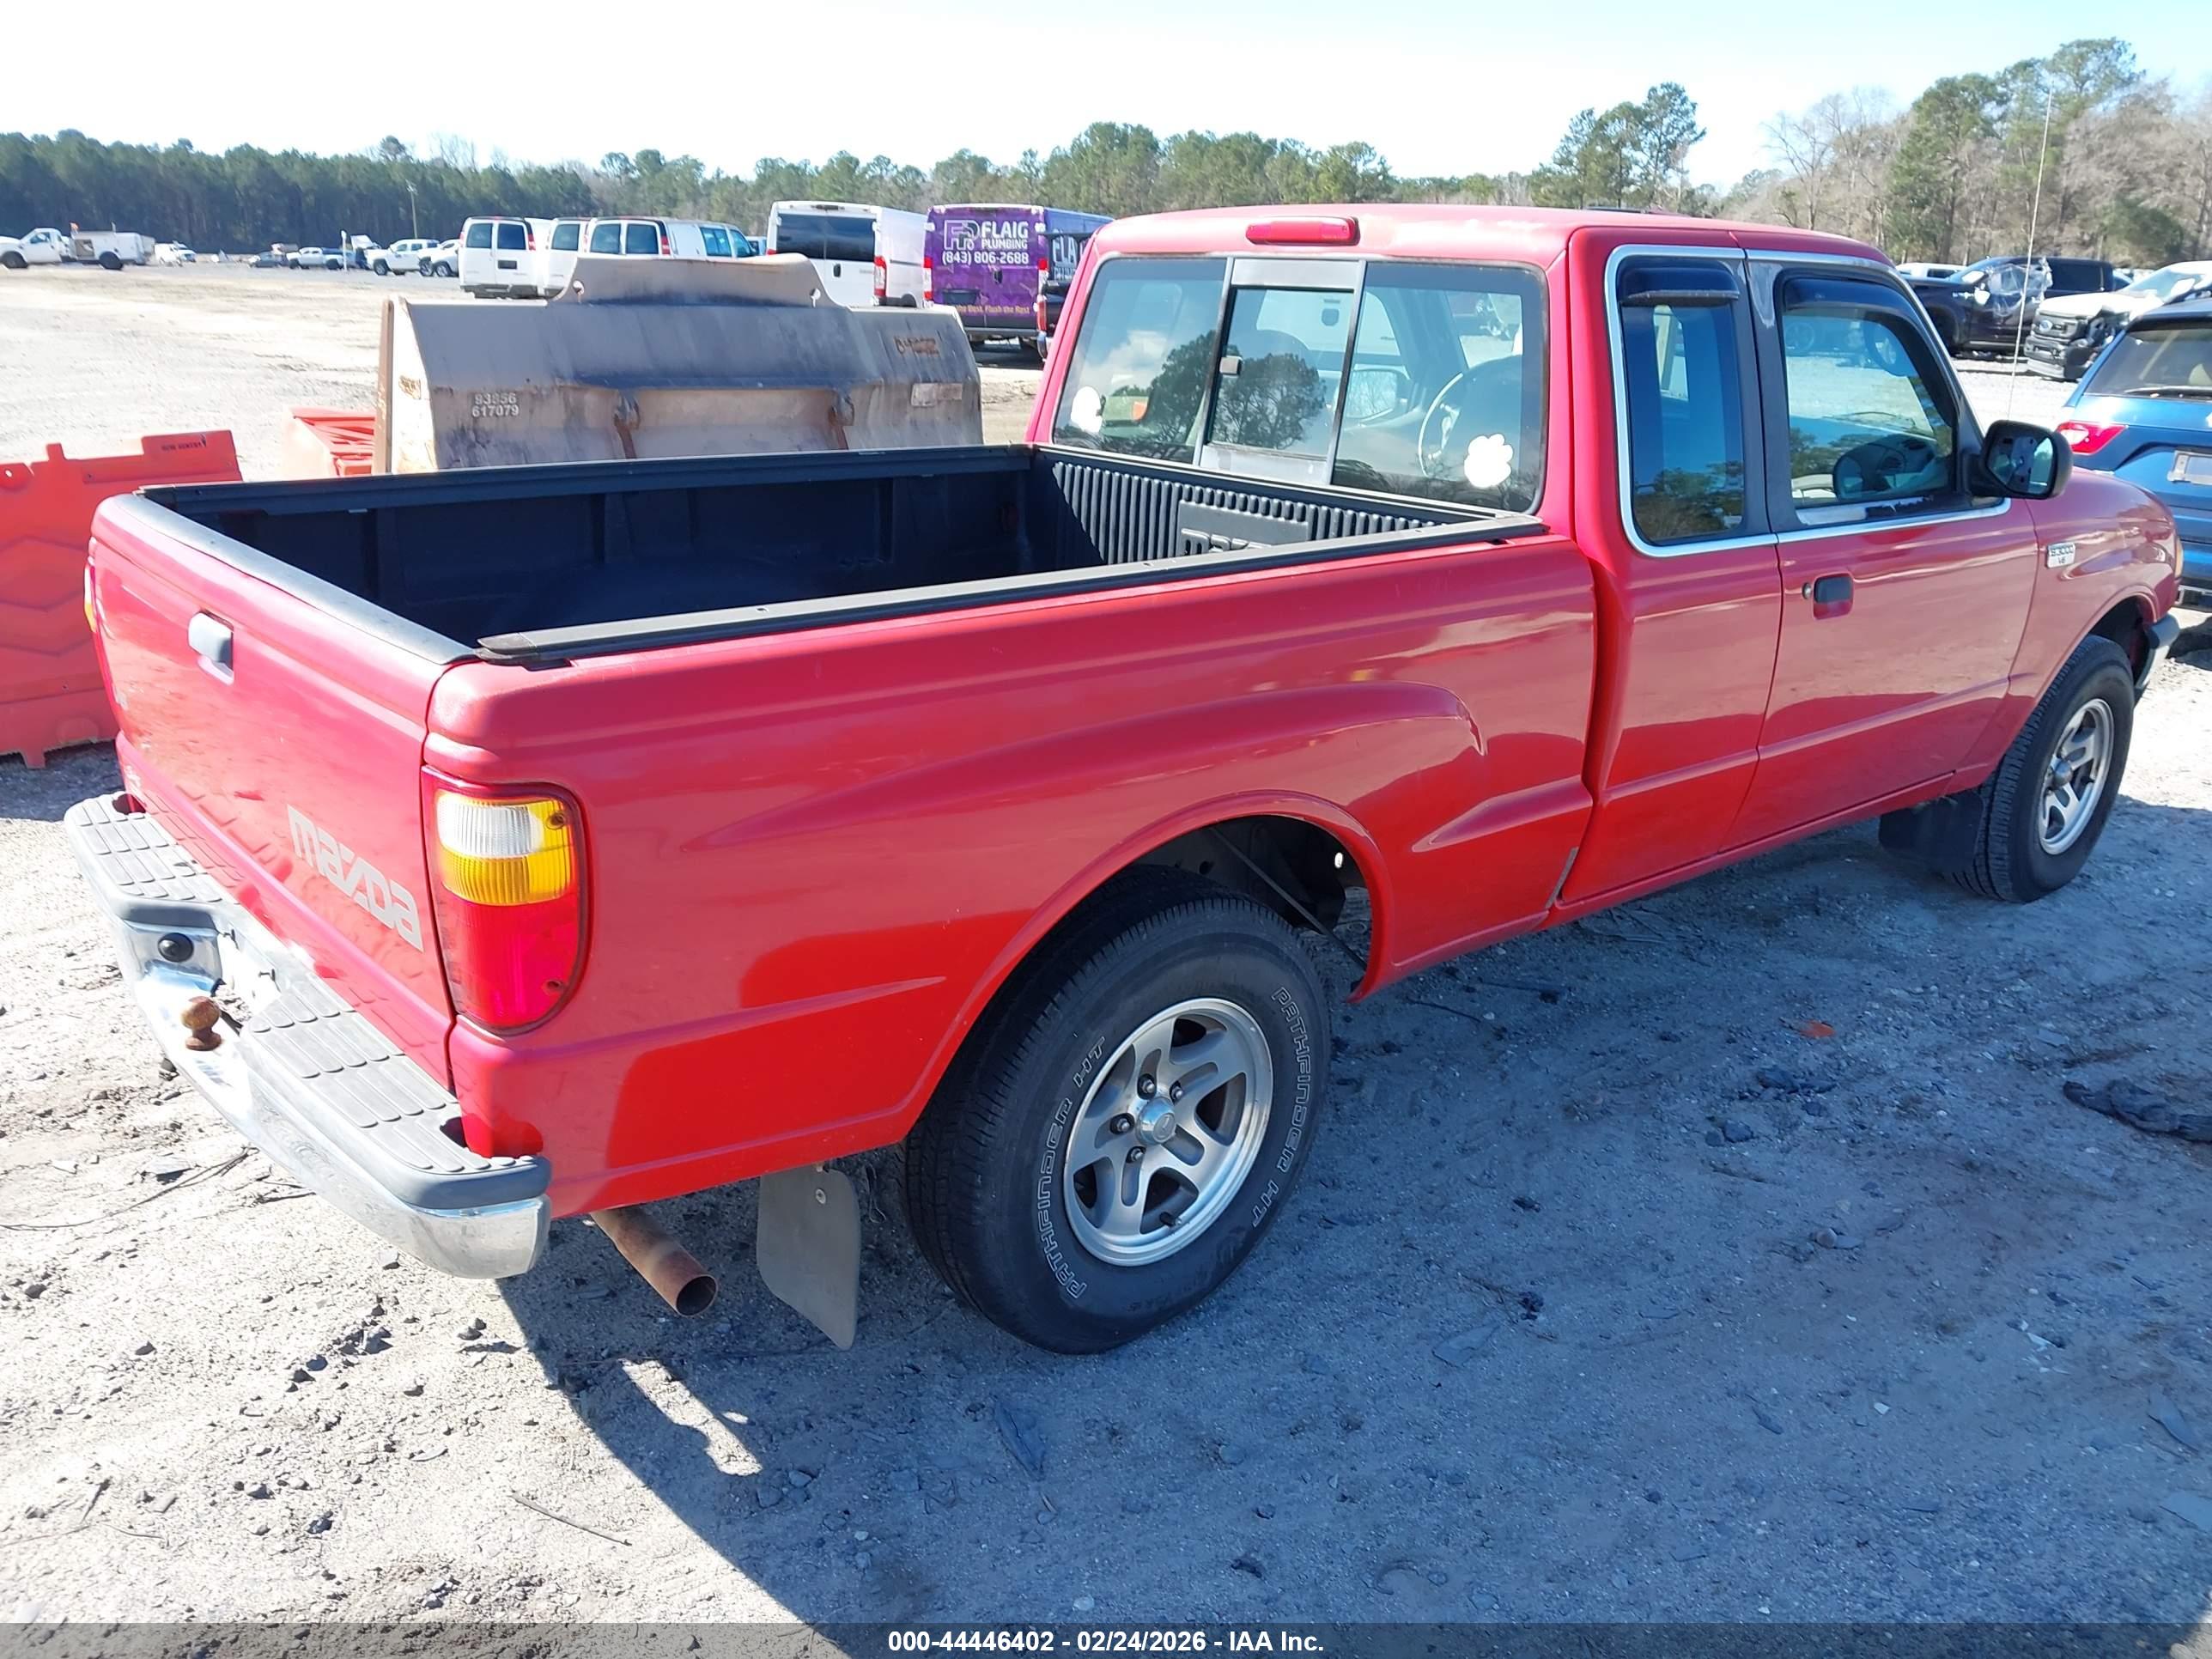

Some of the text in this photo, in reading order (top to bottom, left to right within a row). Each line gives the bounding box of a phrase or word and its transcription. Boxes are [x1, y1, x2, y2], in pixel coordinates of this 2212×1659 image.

[981, 221, 1029, 238] FLAIG
[981, 238, 1028, 250] PLUMBING
[942, 251, 1030, 265] (843) 806-2688
[471, 404, 520, 418] 617079
[1251, 987, 1311, 1228] PATHFINDER HT
[1037, 1036, 1105, 1298] PATHFINDER HT
